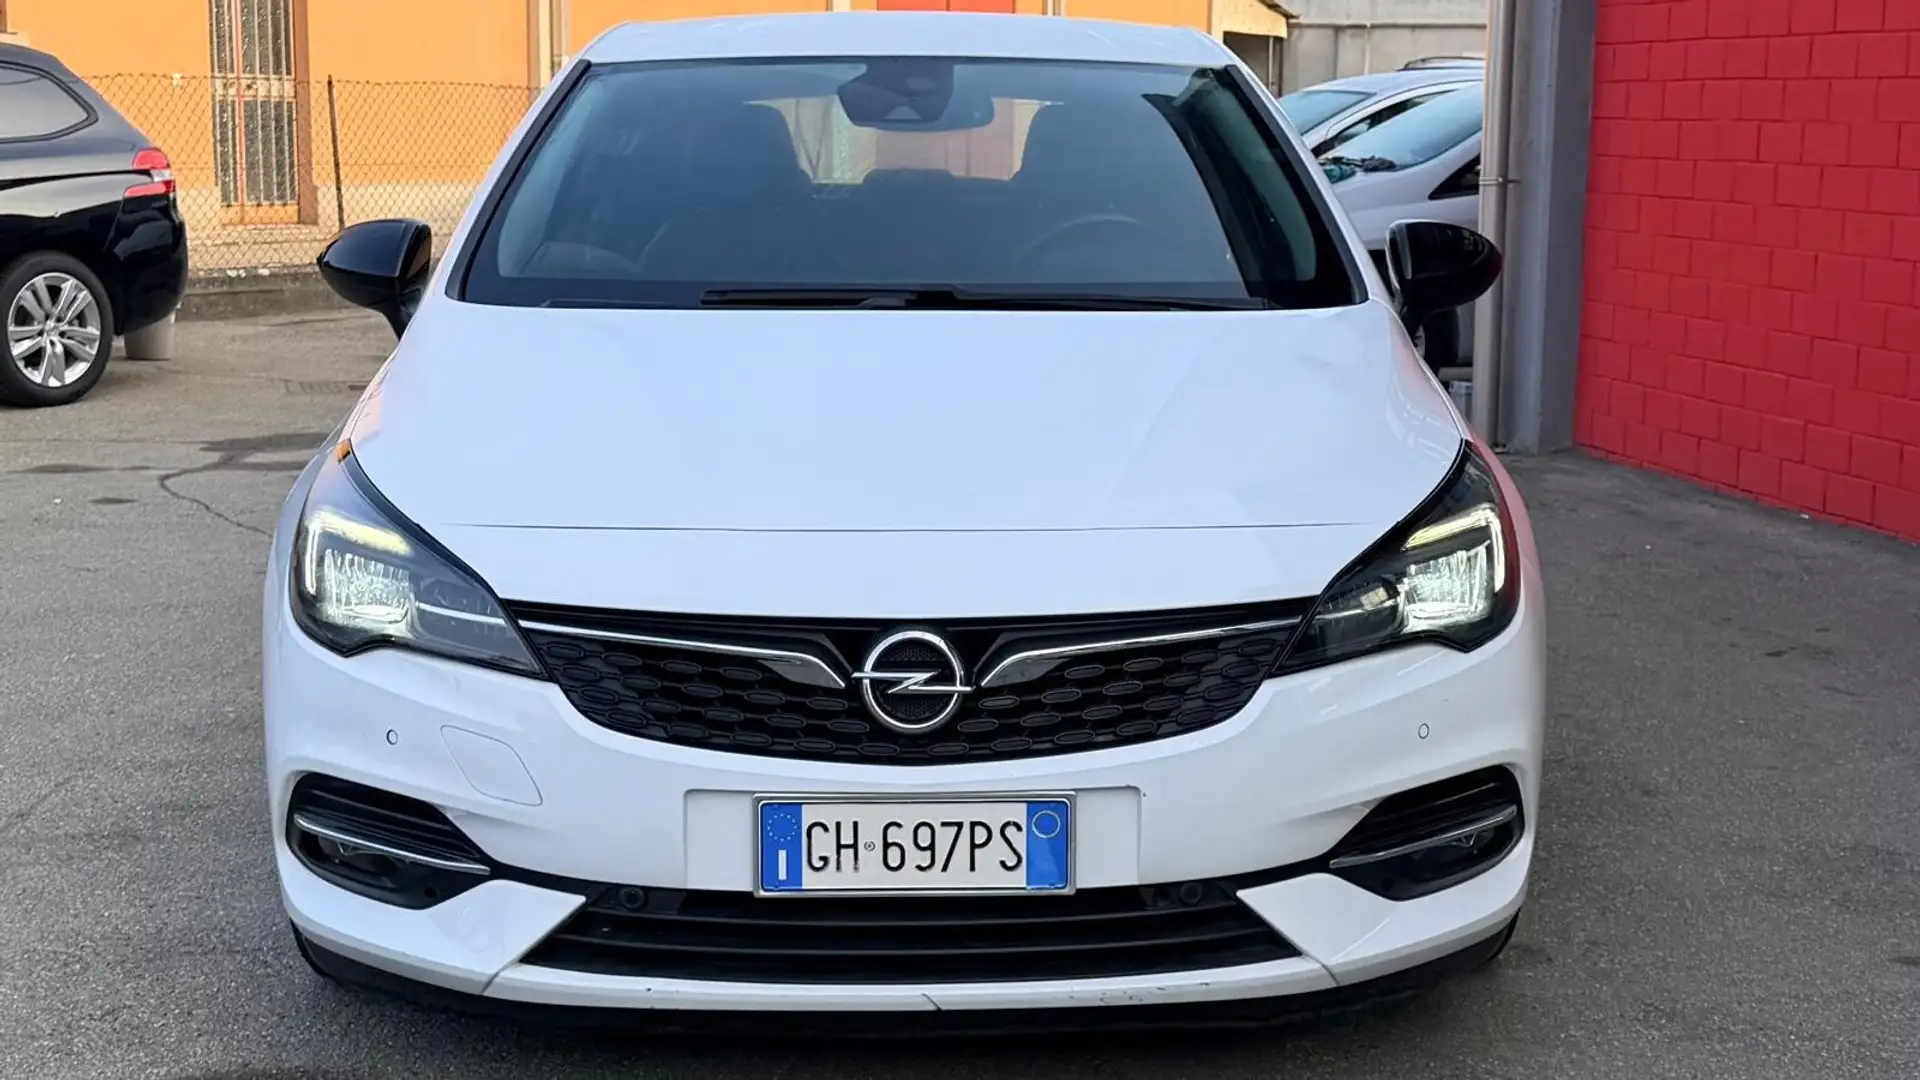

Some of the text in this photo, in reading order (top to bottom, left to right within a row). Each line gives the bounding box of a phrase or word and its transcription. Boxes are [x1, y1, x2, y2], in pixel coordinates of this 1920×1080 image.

[777, 849, 788, 881] I
[806, 820, 1024, 873] GH 697PS
